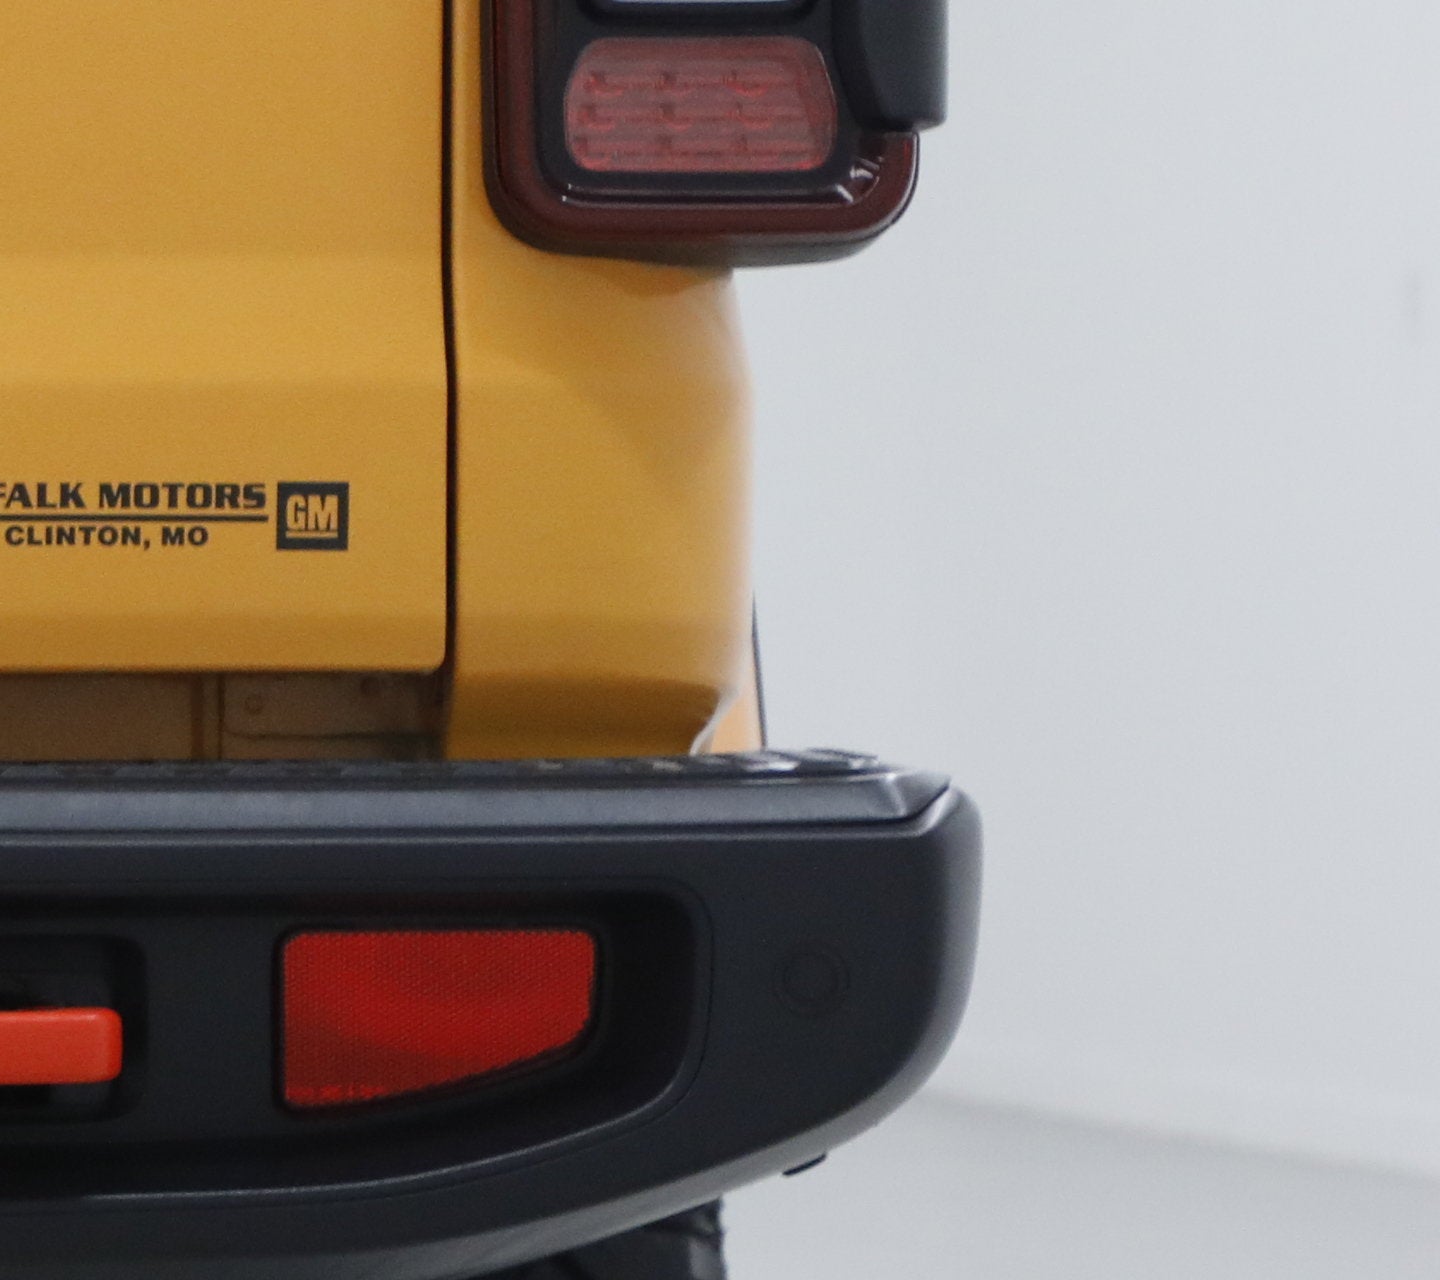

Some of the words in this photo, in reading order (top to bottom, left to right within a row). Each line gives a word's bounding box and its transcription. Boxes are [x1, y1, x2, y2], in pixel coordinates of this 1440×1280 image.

[98, 481, 267, 509] MOTORS
[285, 494, 339, 532] GM
[4, 526, 151, 550] CLINTON,
[161, 525, 209, 546] MO
